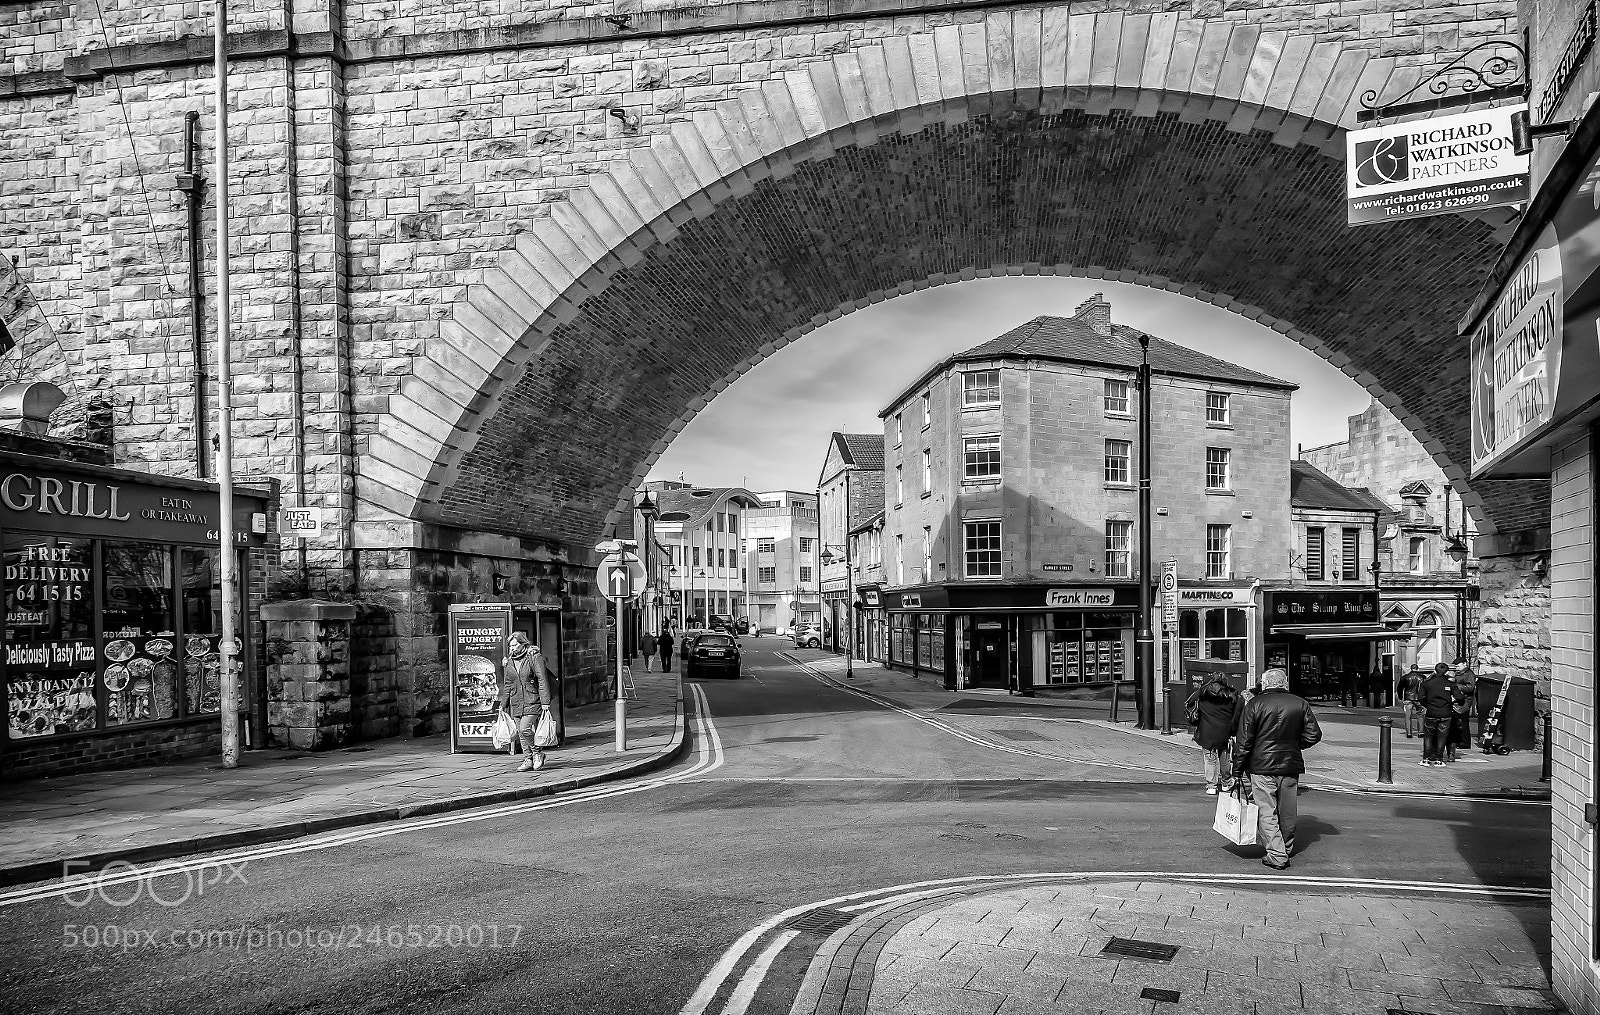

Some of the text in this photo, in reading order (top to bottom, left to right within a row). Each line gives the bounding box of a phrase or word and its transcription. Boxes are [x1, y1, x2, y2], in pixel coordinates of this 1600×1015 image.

[1411, 122, 1493, 147] RICHARD
[1410, 136, 1515, 163] WATKINSON
[1412, 155, 1498, 180] PARTNERS
[1353, 177, 1524, 210] www.richardwatkinson.co.uk
[1385, 193, 1490, 216] Tel: 01623 626990
[1495, 252, 1540, 343] RICHARD
[1495, 291, 1556, 393] WATKINSON
[1496, 370, 1544, 446] PARTNERS
[1, 473, 131, 521] GRILL
[162, 497, 193, 510] EAT IN
[141, 508, 208, 525] OR TAKEAWAY
[285, 511, 310, 521] JUST
[291, 520, 308, 529] EAT
[206, 529, 219, 541] 64
[237, 532, 249, 543] 15
[27, 547, 71, 562] FREE
[5, 565, 91, 582] DELIVERY
[16, 584, 82, 601] 64 15 15
[1051, 591, 1111, 604] Frank Innes
[1181, 591, 1234, 600] MARTIN&CO
[6, 612, 44, 621] JUST EAT
[1291, 602, 1306, 614] The
[458, 627, 502, 636] HUNGRY
[458, 635, 503, 644] HUNGRY?
[6, 641, 95, 668] Deliciously Tasty Pizza
[471, 725, 493, 735] KF
